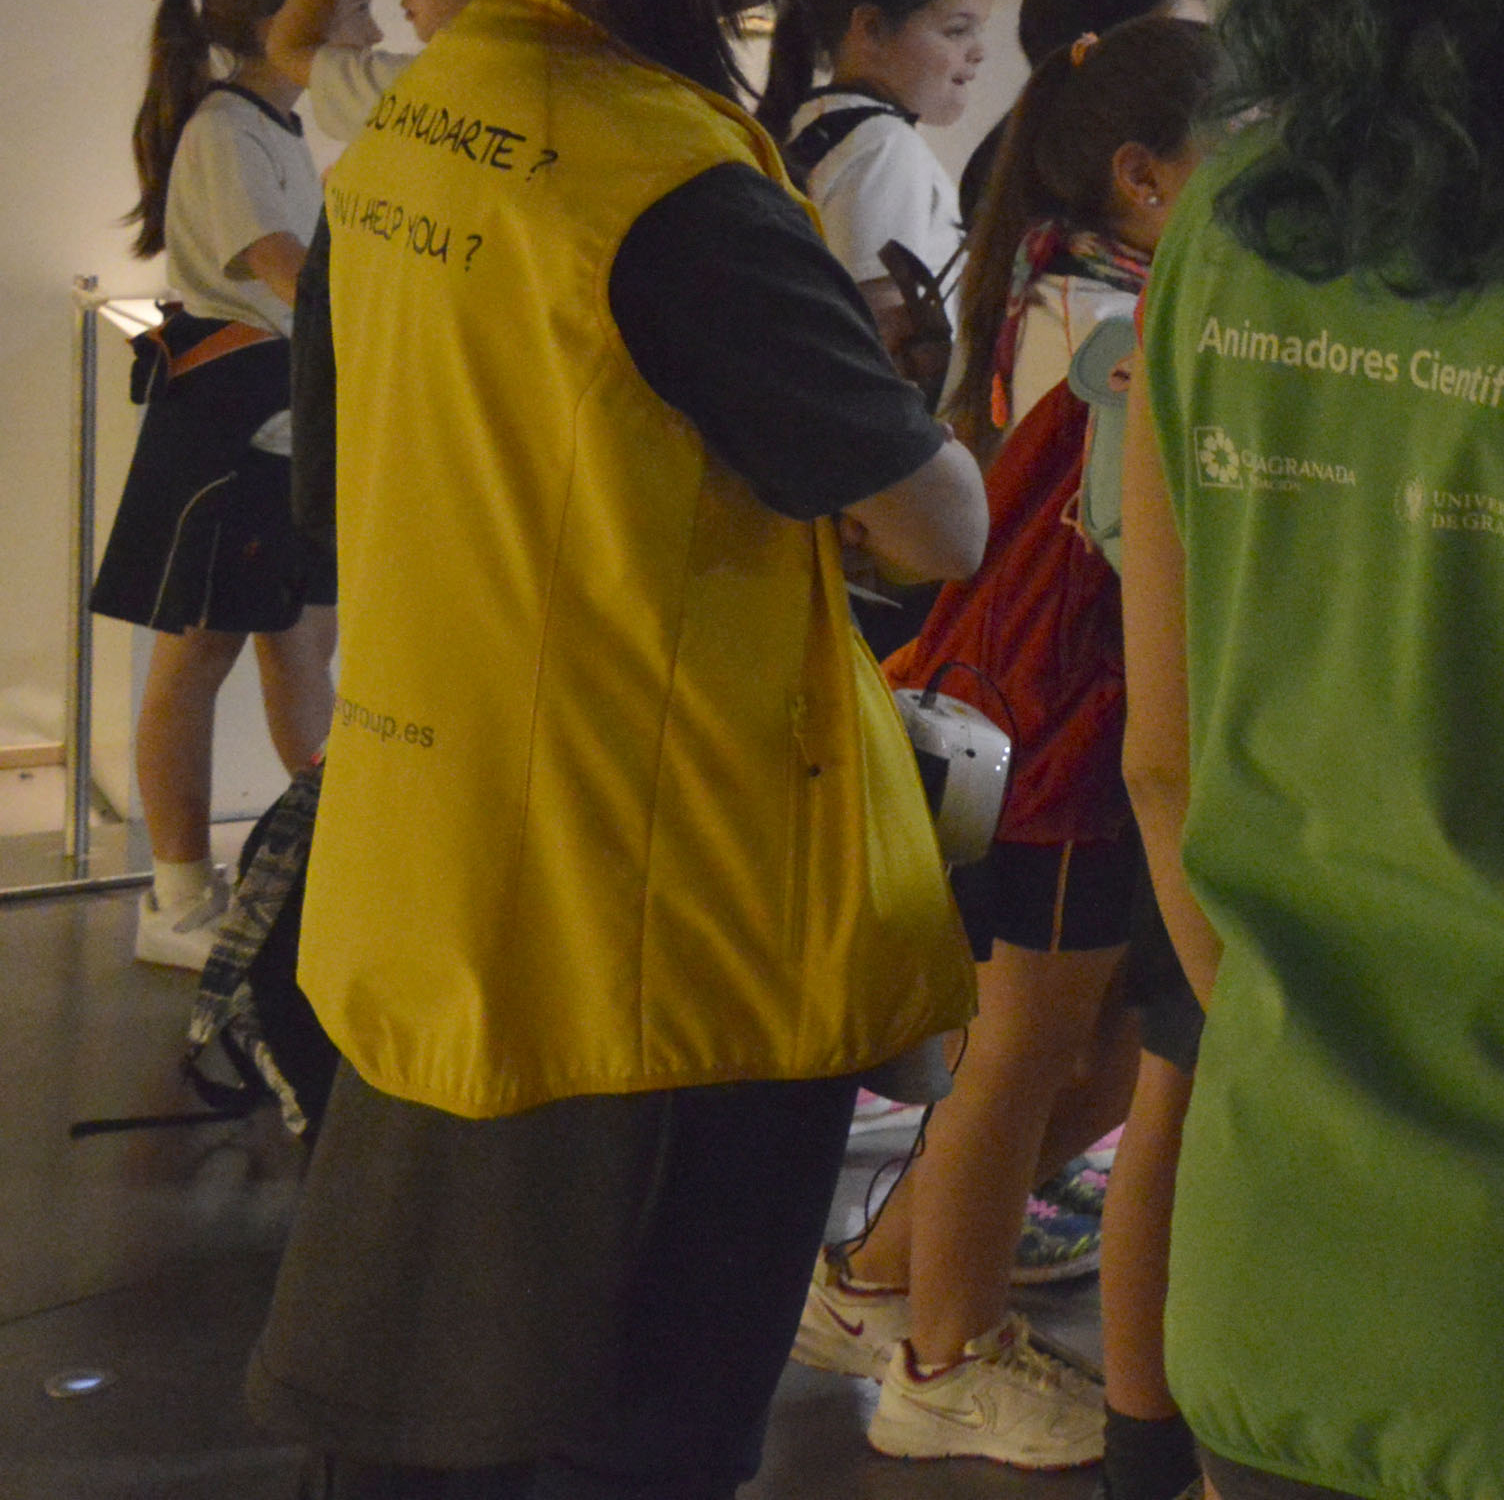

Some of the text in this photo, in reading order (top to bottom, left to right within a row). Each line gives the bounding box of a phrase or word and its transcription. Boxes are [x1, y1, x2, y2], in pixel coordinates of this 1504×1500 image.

[397, 102, 526, 170] AYUDARTE
[360, 200, 404, 241] HELP
[406, 215, 451, 264] YOU
[1196, 316, 1400, 383] Animadores
